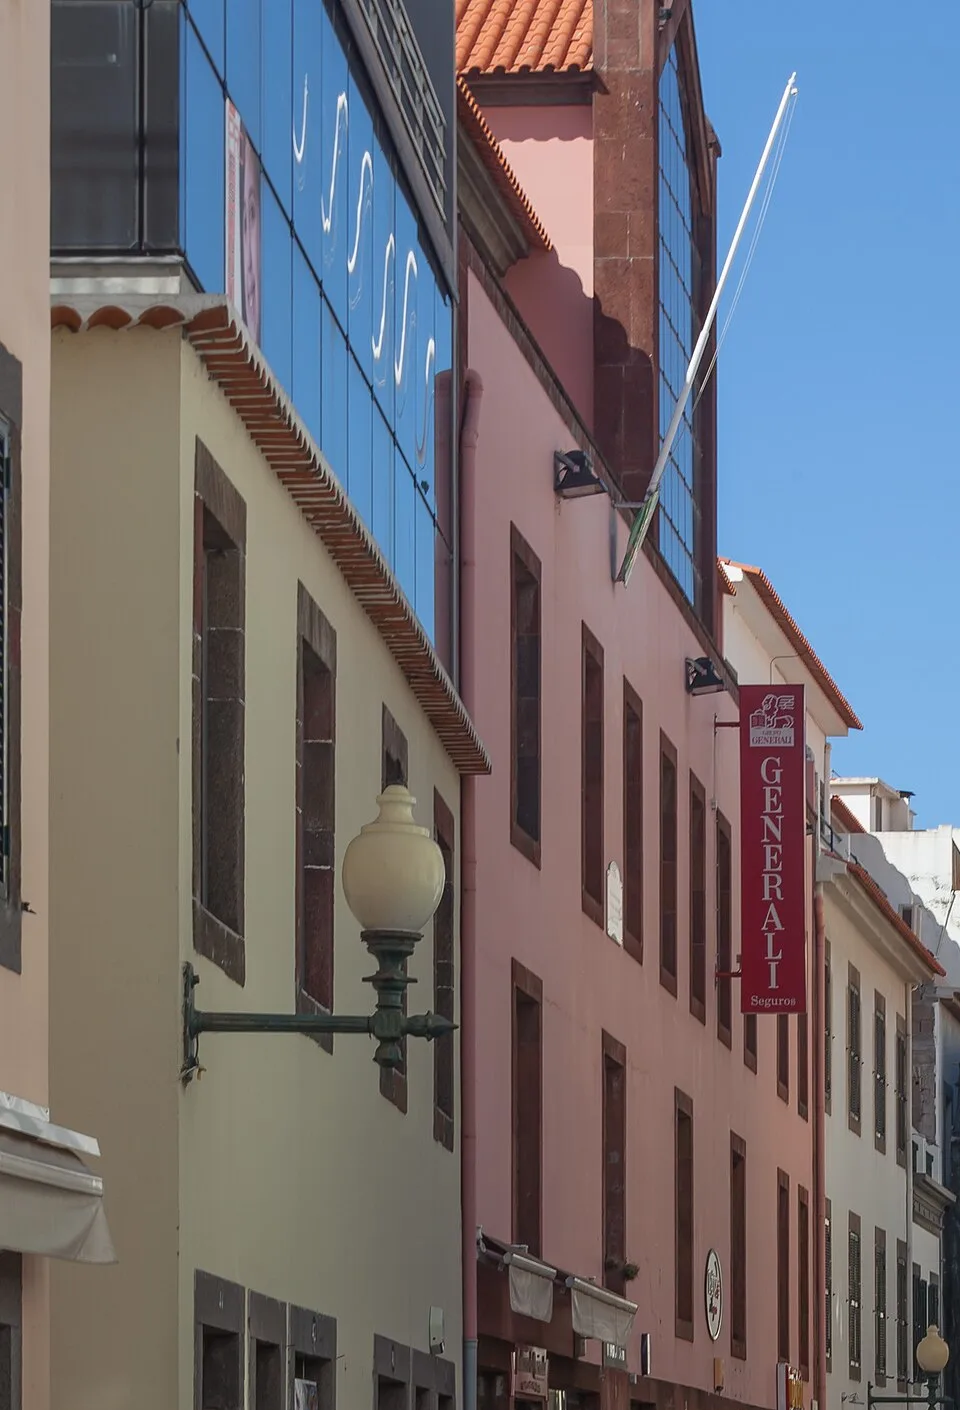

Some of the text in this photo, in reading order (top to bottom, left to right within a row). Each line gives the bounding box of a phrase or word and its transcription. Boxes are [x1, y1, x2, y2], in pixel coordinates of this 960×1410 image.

[752, 736, 792, 745] GENERALI
[760, 757, 785, 989] GENERALI
[750, 996, 796, 1007] Seguros
